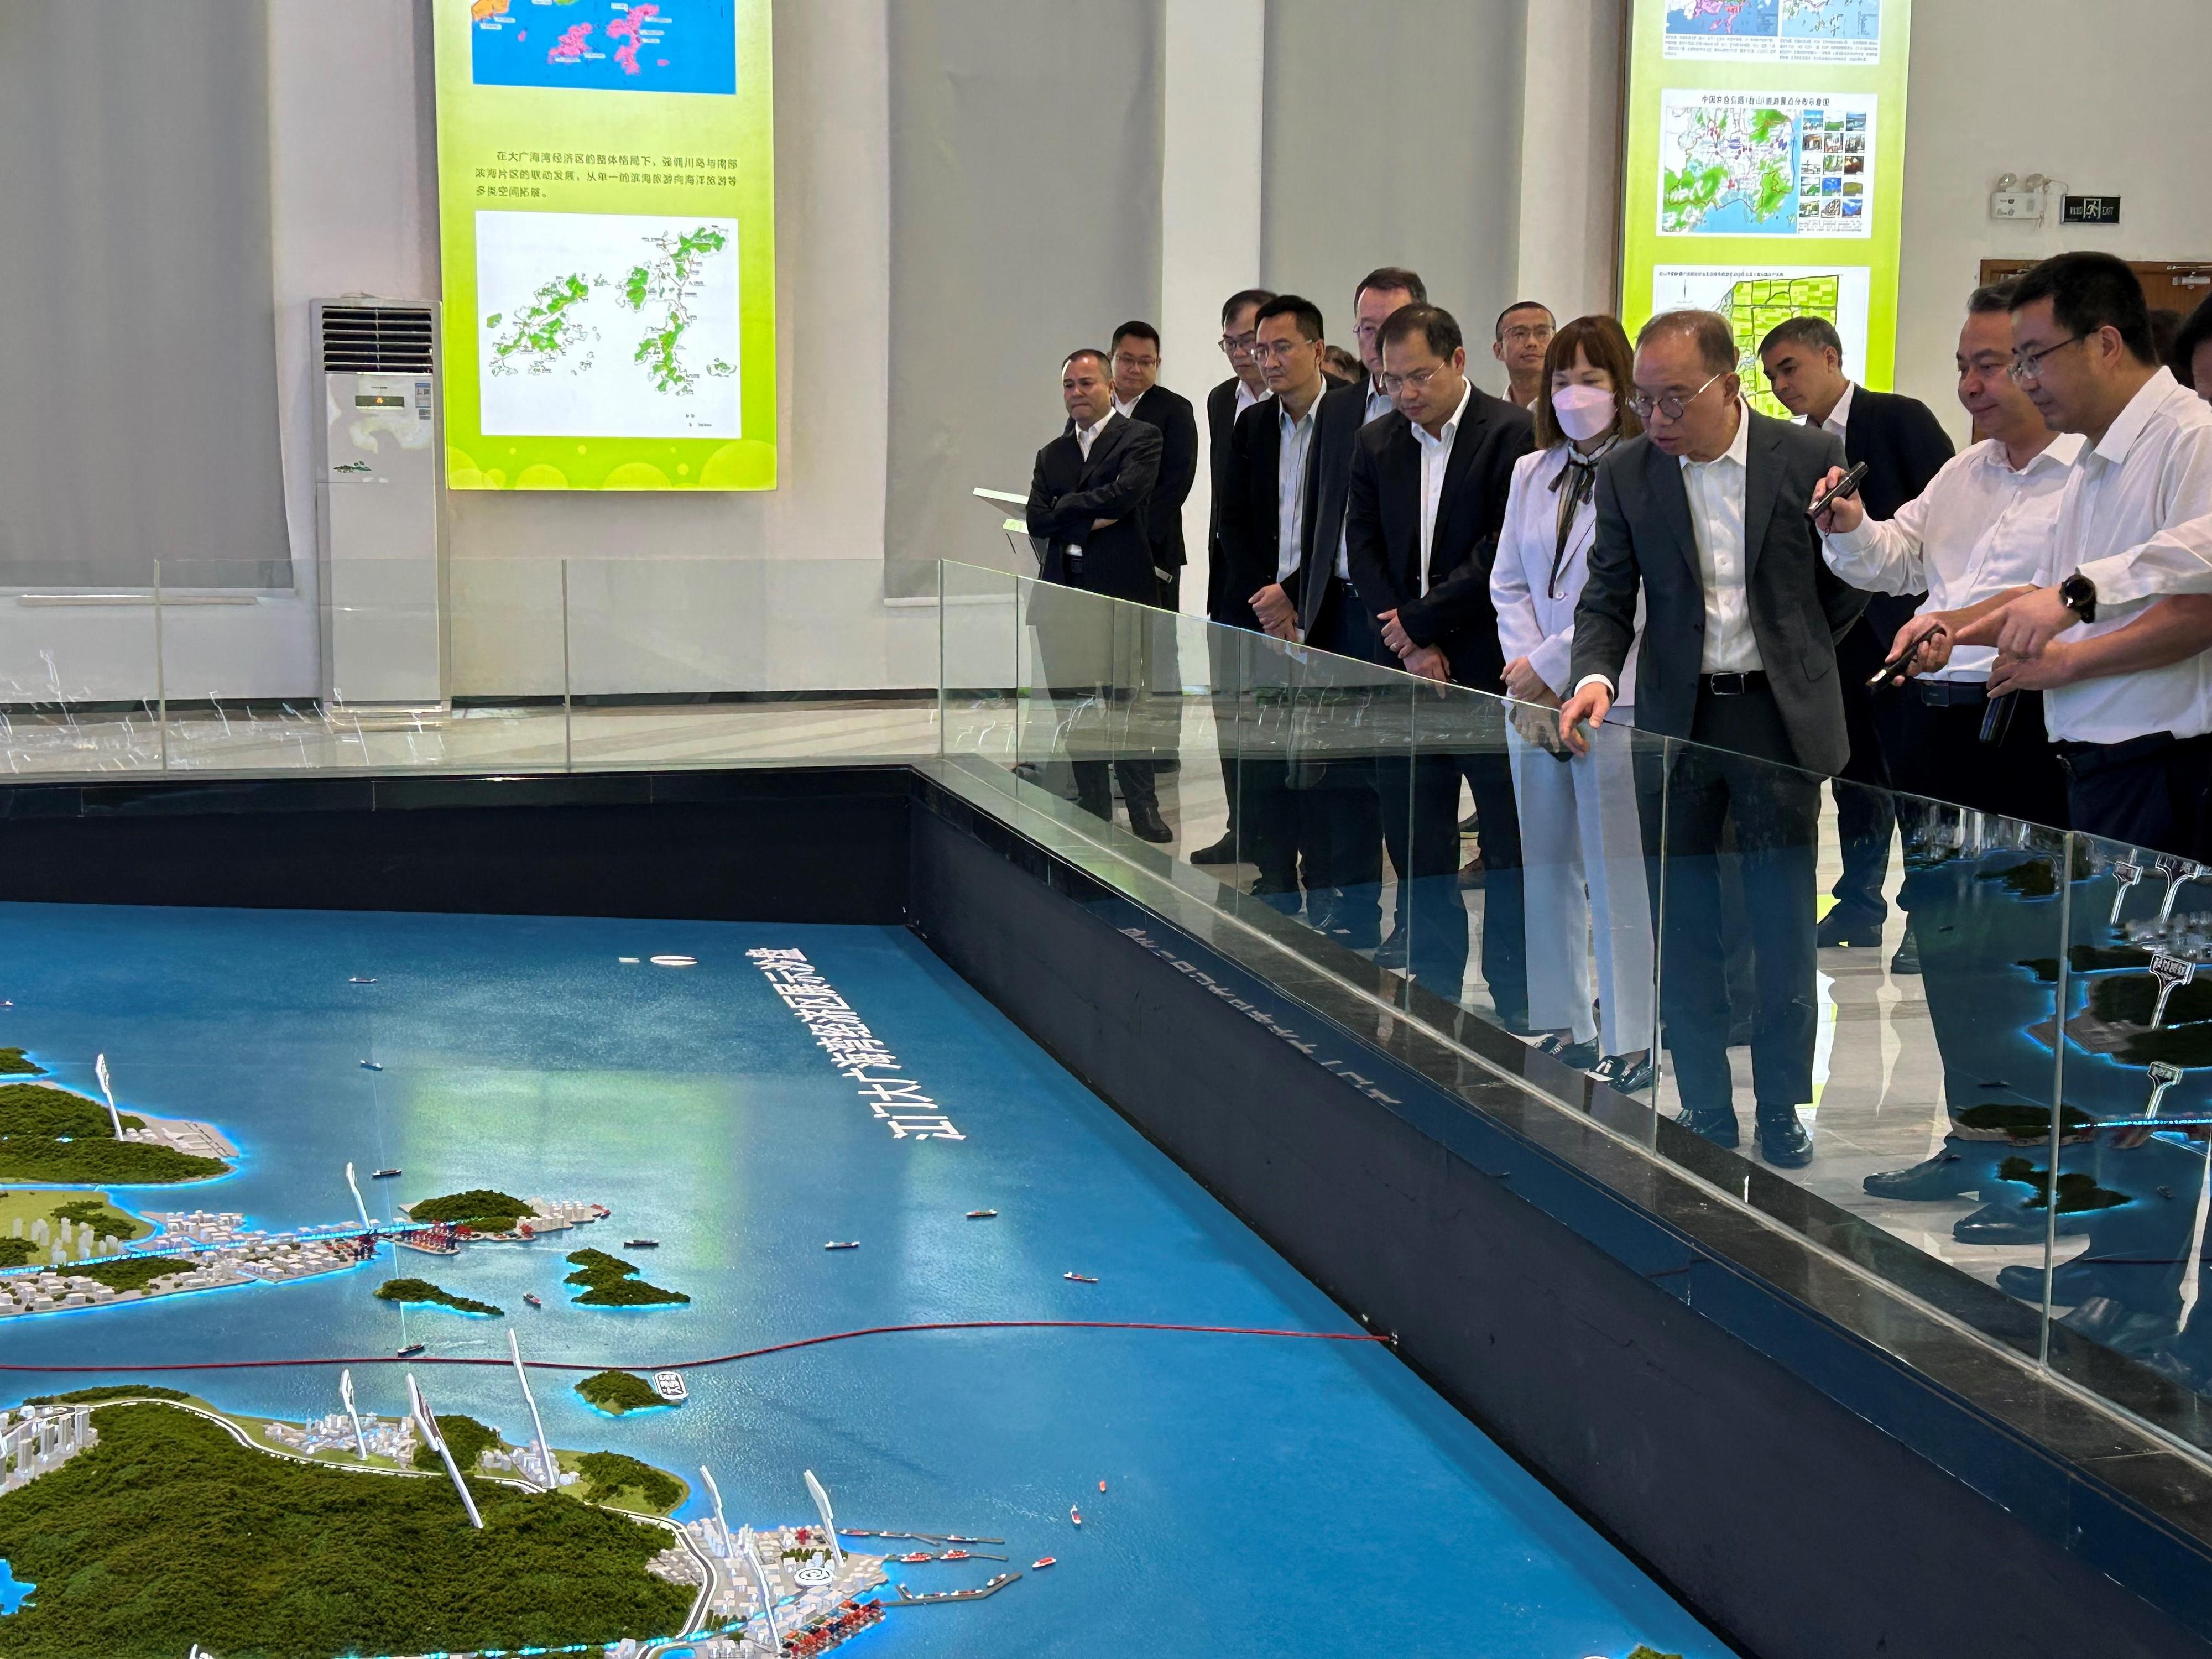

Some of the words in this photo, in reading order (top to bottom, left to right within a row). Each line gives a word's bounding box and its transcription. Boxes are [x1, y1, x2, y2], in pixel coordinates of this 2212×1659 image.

[745, 947, 966, 1139] 江门大广海湾经济区展示沙盘
